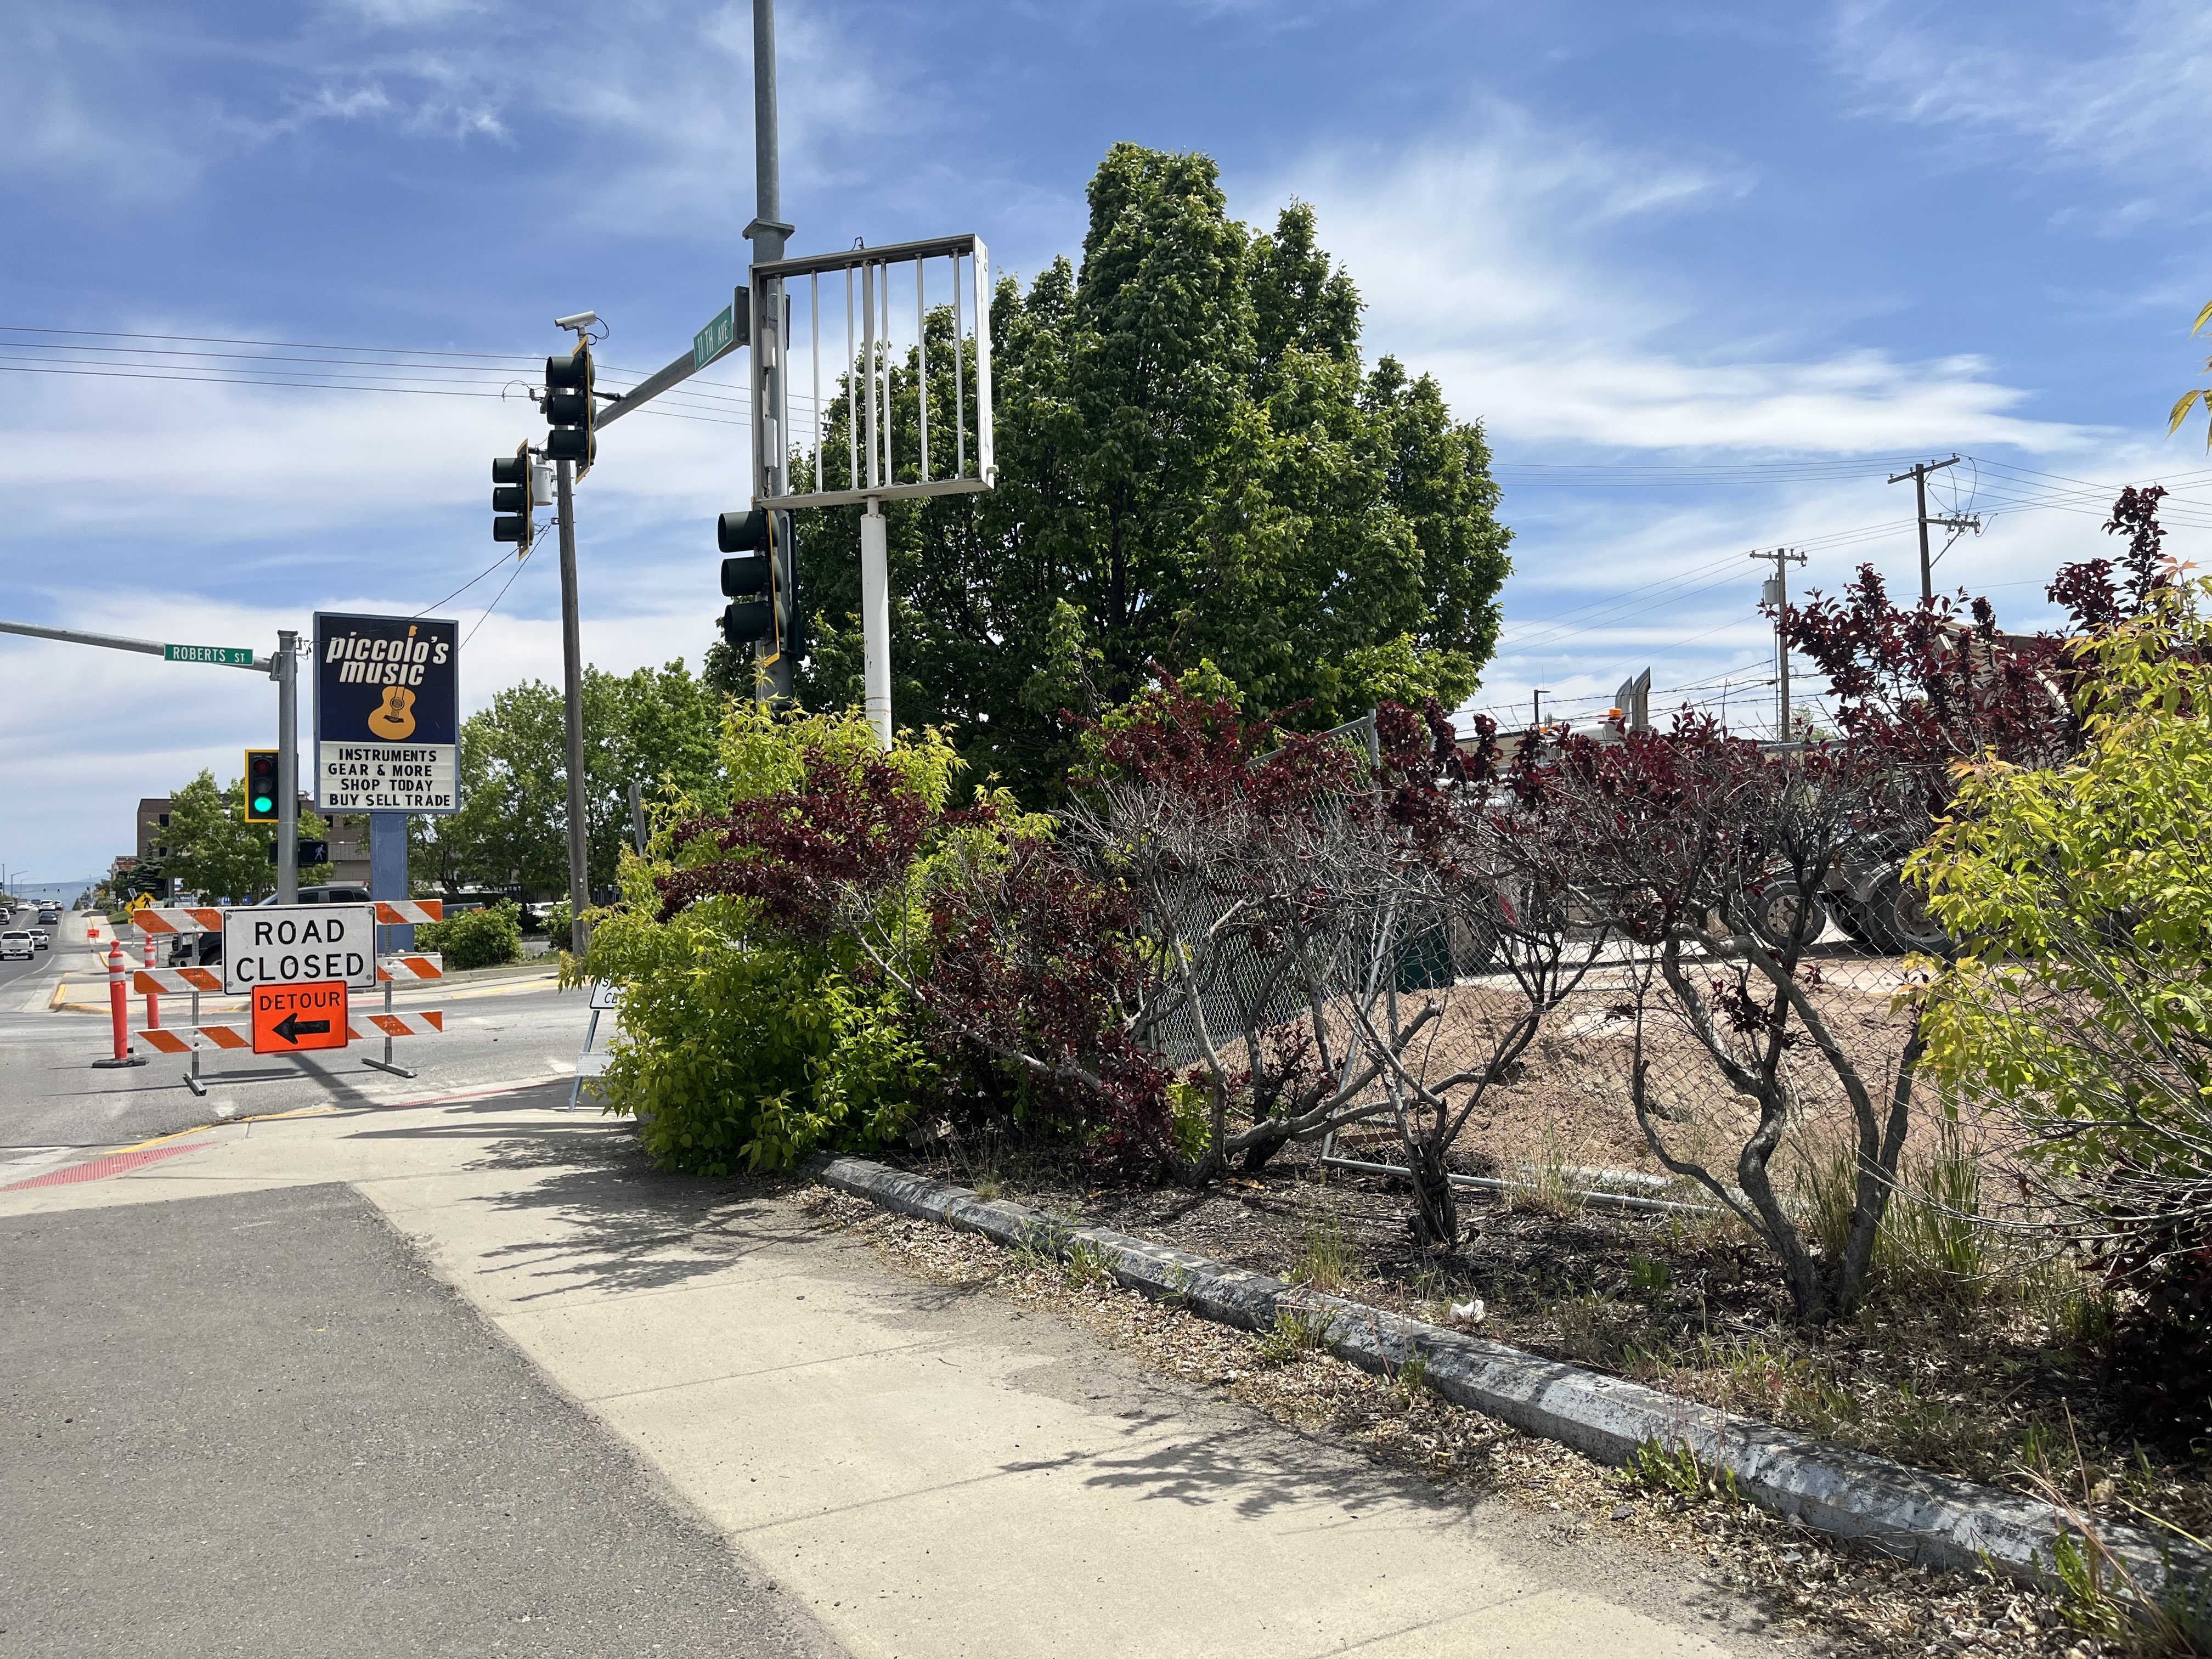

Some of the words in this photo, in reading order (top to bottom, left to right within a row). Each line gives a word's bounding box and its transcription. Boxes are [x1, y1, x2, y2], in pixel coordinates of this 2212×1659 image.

[697, 335, 703, 363] 11
[704, 326, 713, 356] TH
[718, 320, 728, 346] AVE
[173, 646, 225, 662] ROBERTS
[326, 631, 449, 664] piccolo's
[339, 661, 425, 686] music
[339, 748, 437, 762] INSTRUMENTS
[328, 763, 369, 776] GEAR
[377, 765, 386, 776] &
[392, 765, 432, 777] MORE
[341, 778, 380, 791] SHOP
[389, 779, 433, 792] TODAY
[330, 794, 359, 806] BUY
[365, 794, 400, 806] SELL
[405, 794, 450, 807] TRADE
[255, 919, 345, 946] ROAD
[236, 953, 364, 982] CLOSED
[260, 991, 341, 1011] DETOUR
